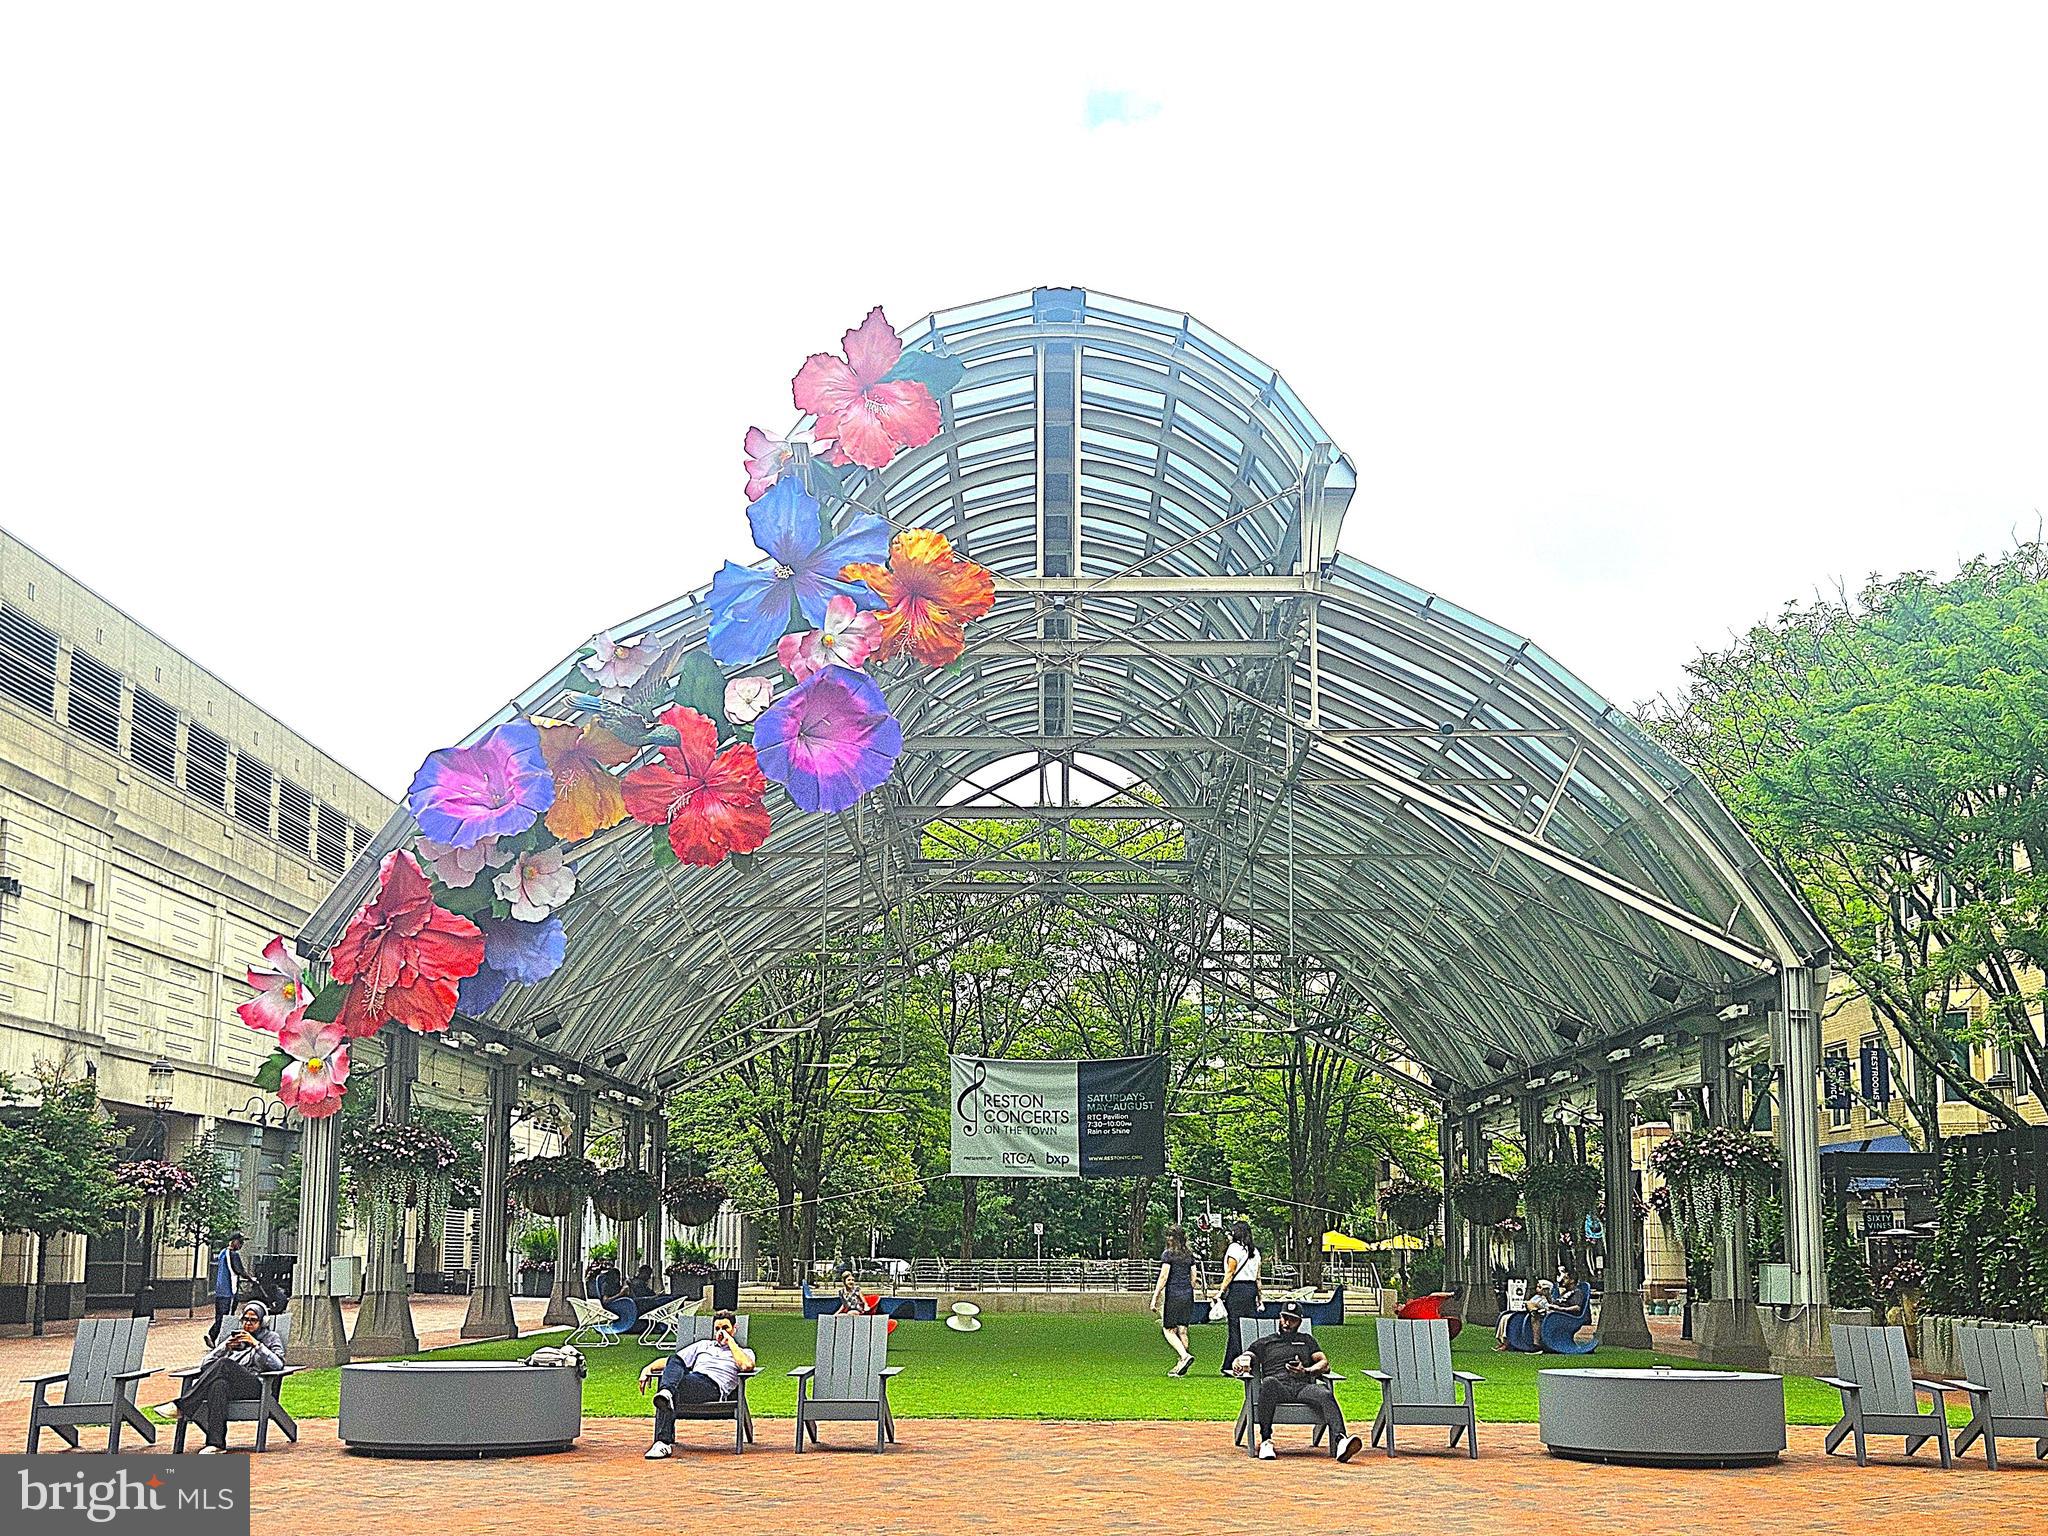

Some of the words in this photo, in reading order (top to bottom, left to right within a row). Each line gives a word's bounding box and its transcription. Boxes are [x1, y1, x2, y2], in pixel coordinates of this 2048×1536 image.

[1870, 1050, 1880, 1100] RESTROOMS
[984, 1093, 1044, 1108] RESTON
[1087, 1092, 1146, 1103] SATURDAYS
[984, 1109, 1070, 1124] CONCERTS
[1087, 1113, 1102, 1121] RTC
[1102, 1113, 1129, 1121] Pavilion
[984, 1125, 1000, 1134] ON
[1004, 1125, 1022, 1134] THE
[1026, 1126, 1058, 1135] TOWN
[1111, 1127, 1131, 1135] Shine
[1002, 1152, 1036, 1164] RTCA
[1046, 1152, 1070, 1167] bxp
[1866, 1214, 1892, 1222] SIXTY
